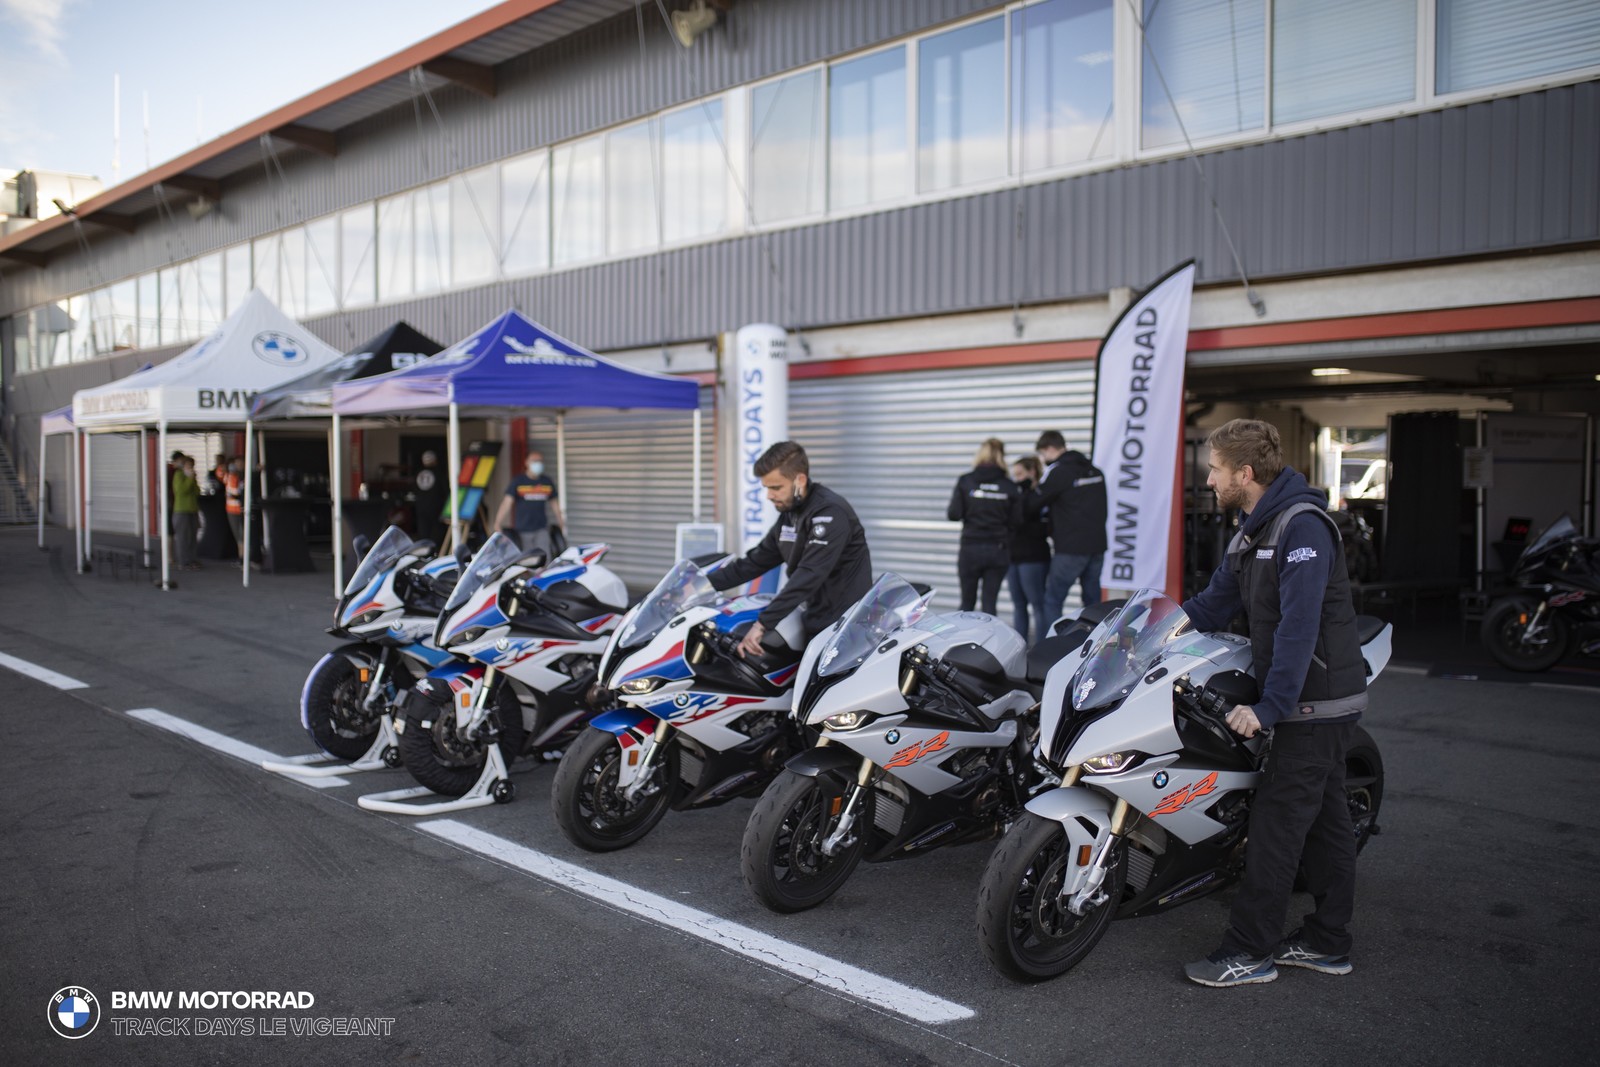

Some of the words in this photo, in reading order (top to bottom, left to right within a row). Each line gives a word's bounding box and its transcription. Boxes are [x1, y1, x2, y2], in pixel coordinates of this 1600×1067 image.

[744, 369, 763, 543] TRACKDAYS
[1118, 309, 1157, 490] MOTORRAD
[1112, 502, 1139, 581] BMW
